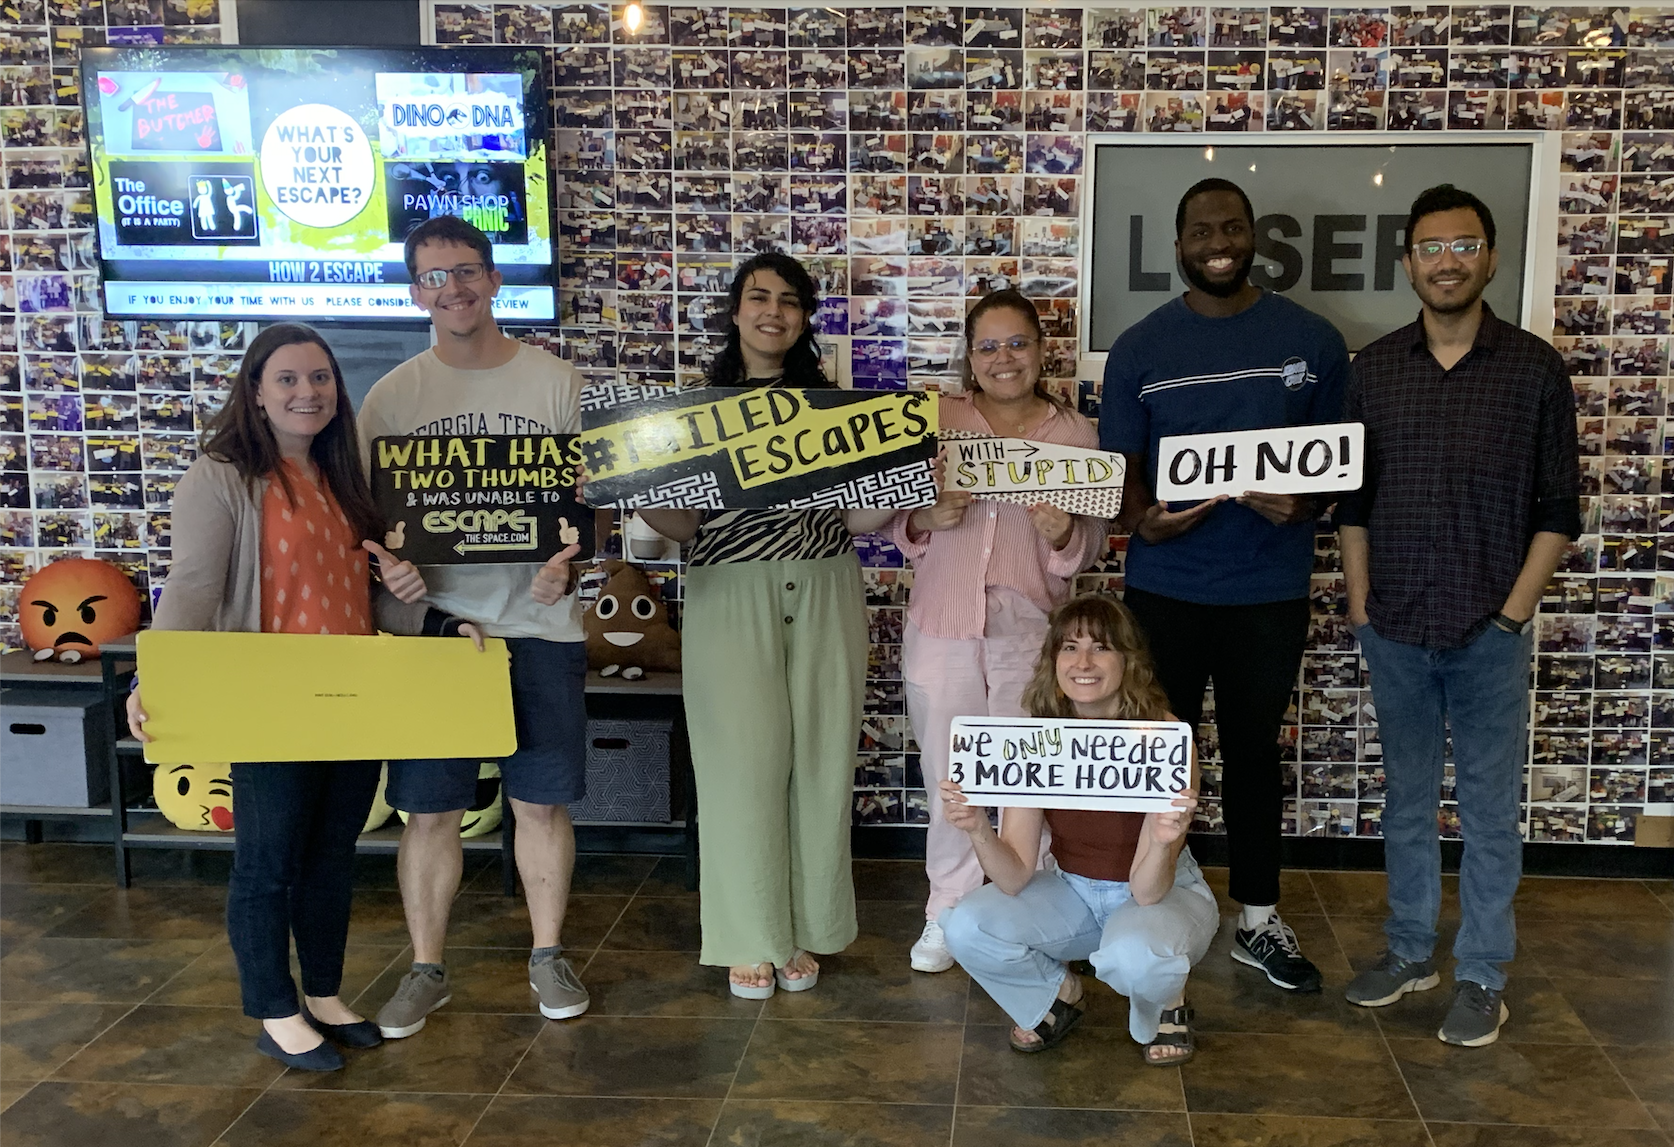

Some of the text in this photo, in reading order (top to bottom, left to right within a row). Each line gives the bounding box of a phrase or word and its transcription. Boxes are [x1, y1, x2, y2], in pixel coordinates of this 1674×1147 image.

[140, 94, 179, 114] THE
[137, 105, 215, 138] BUTCHER
[392, 104, 515, 127] DINO DNA
[276, 126, 354, 143] WHAT'S
[291, 146, 342, 163] YOUR
[114, 178, 145, 192] The
[293, 167, 342, 183] NEXT
[118, 195, 184, 216] Office
[277, 187, 362, 204] ESCAPE?
[403, 194, 509, 212] PAWN SHOP
[134, 217, 141, 226] IS
[144, 217, 151, 226] A
[463, 206, 510, 232] PANIC
[1129, 213, 1411, 292] LSER
[269, 261, 384, 283] HOW 2 ESCAPE
[128, 295, 137, 305] IF
[143, 295, 164, 305] YOU
[169, 295, 201, 305] ENJOY
[208, 295, 234, 306] YOUR
[240, 296, 263, 306] TIME
[269, 297, 296, 306] WITH
[301, 297, 315, 306] US
[326, 297, 362, 307] PLEASE
[404, 412, 489, 436] EORGIA
[581, 389, 801, 476] #ILED
[377, 436, 583, 469] WHAT HAS
[959, 441, 1005, 461] WITH
[1169, 435, 1350, 486] OH NO!
[391, 467, 576, 490] TWO THUMBS
[956, 457, 1113, 488] STUPID
[405, 490, 561, 507] & WAS UNABLE TO
[465, 532, 530, 543] THE SPACE.COM
[951, 761, 1187, 794] 3 MORE HOURS
